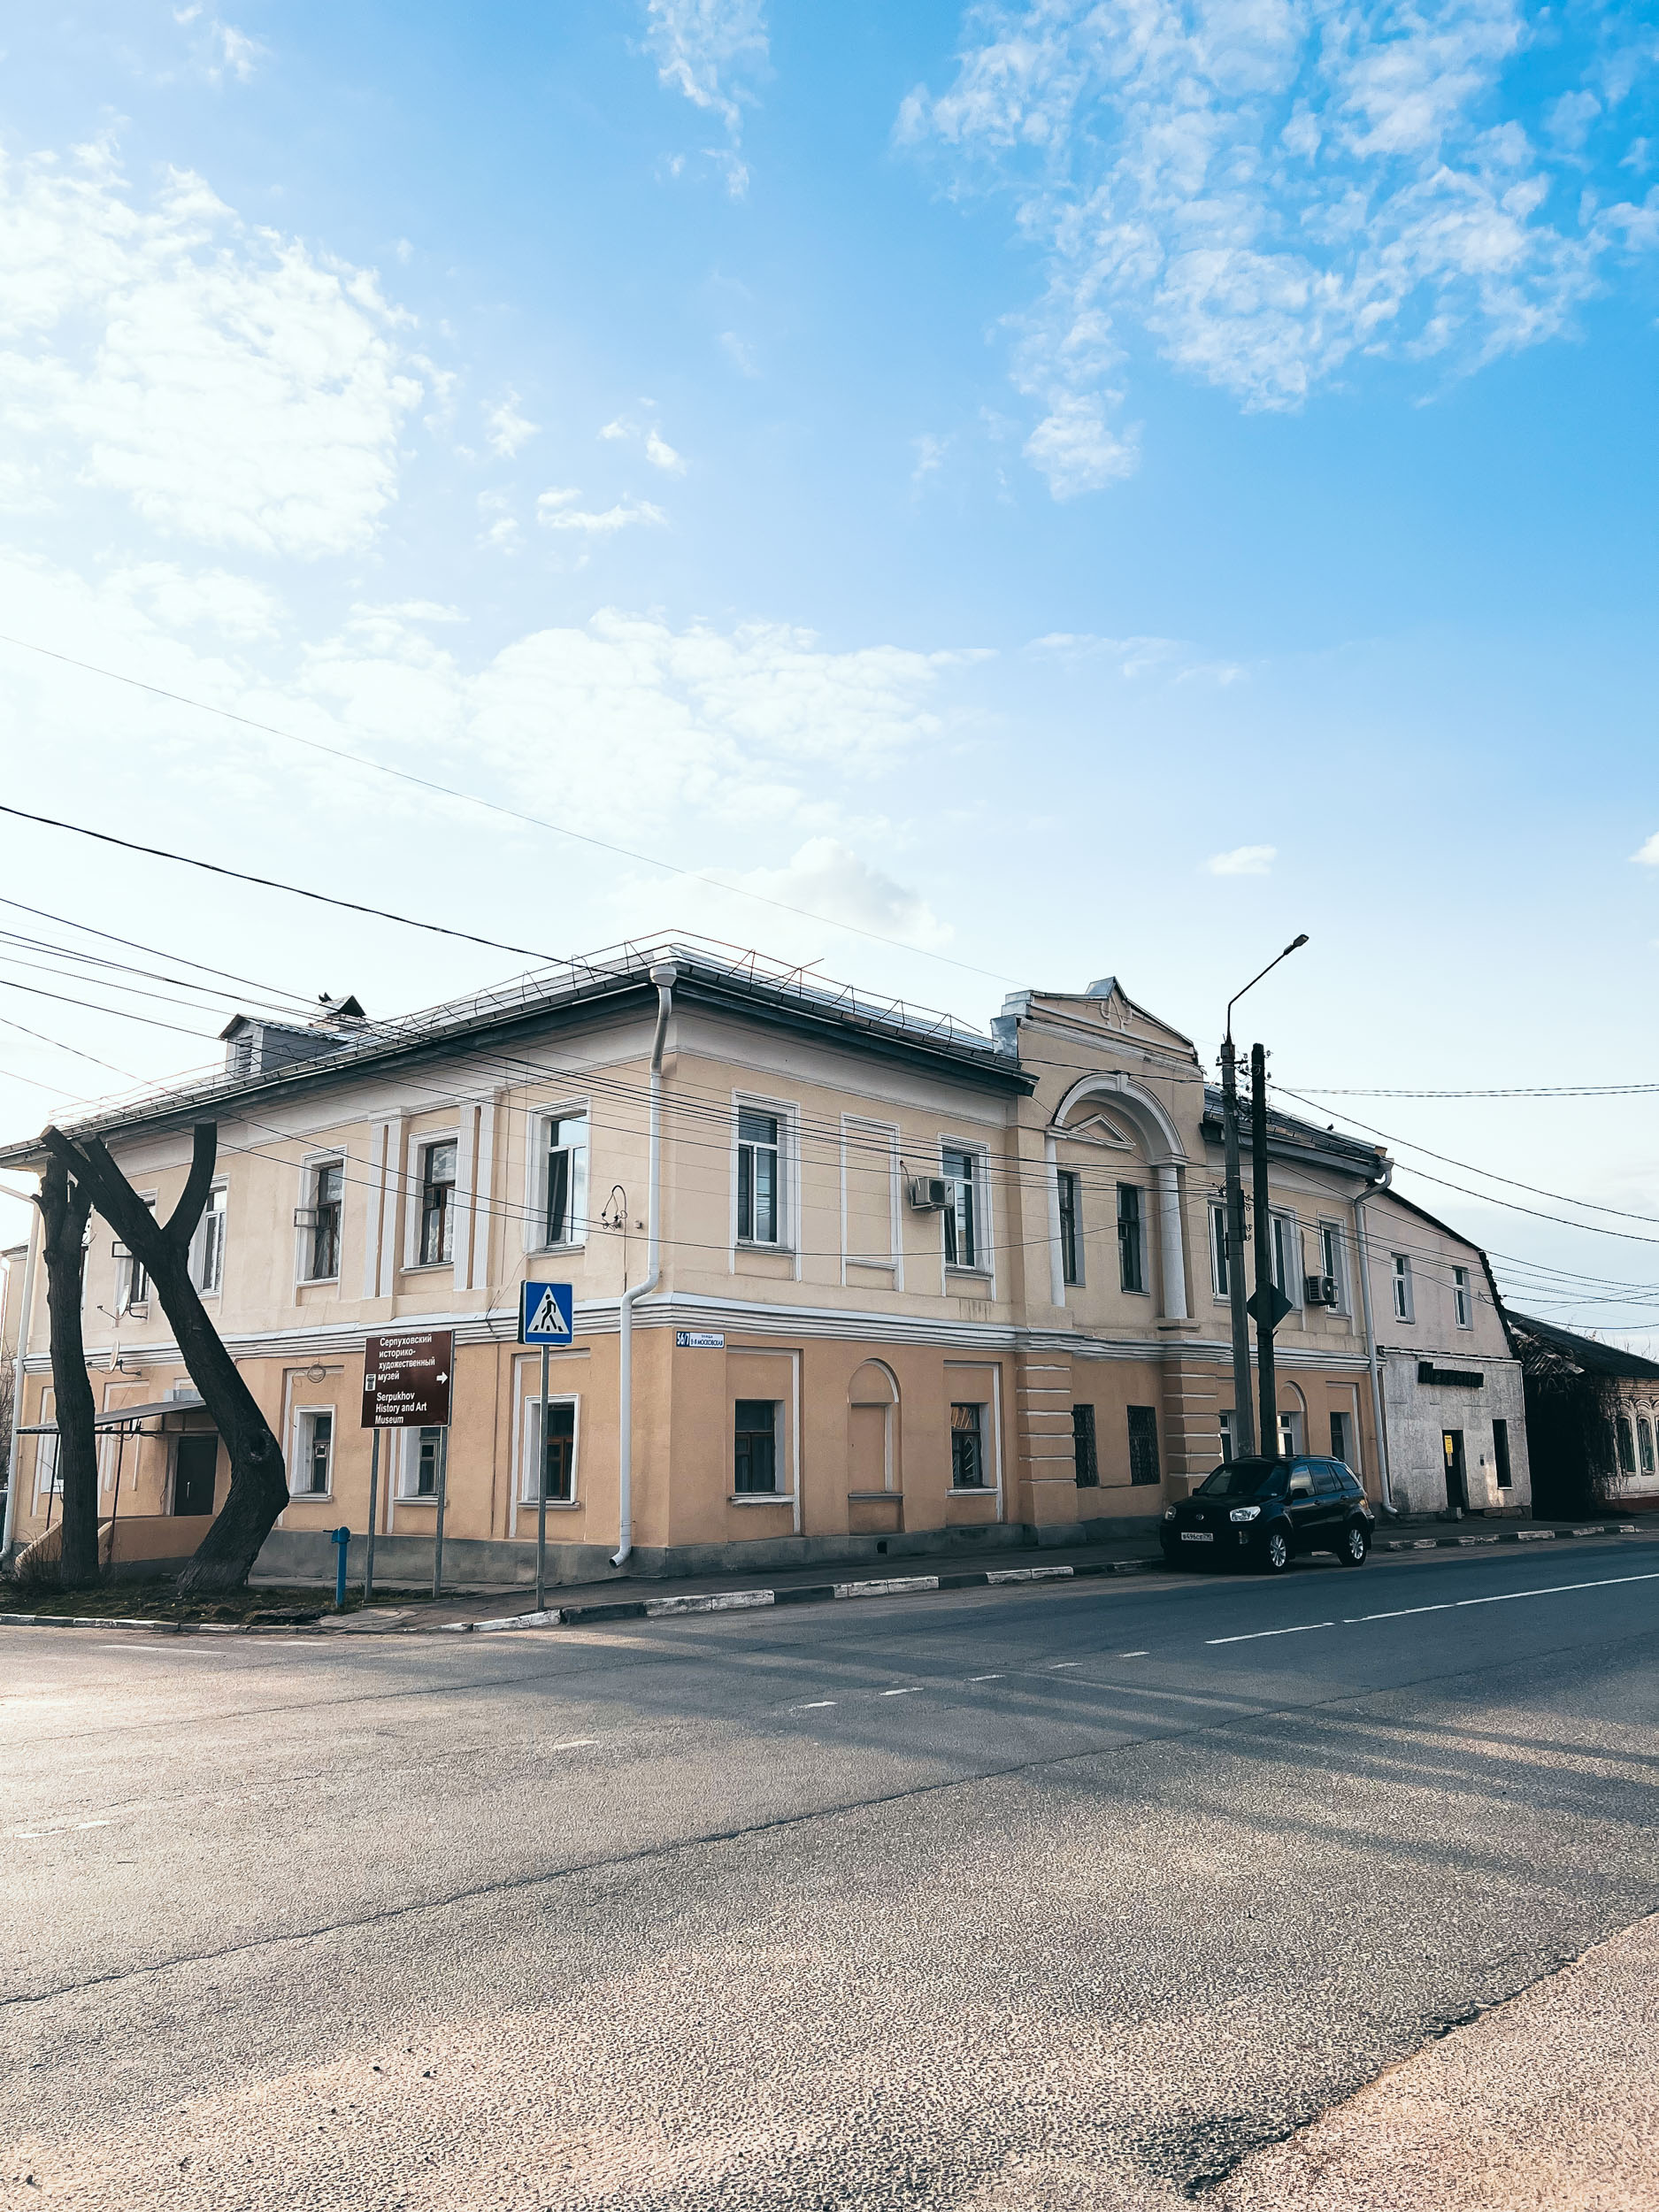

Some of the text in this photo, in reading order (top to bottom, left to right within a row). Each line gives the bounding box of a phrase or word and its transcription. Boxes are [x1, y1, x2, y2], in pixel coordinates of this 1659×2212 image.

[380, 1334, 432, 1347] Серпуховский
[677, 1333, 689, 1345] 56/7
[379, 1348, 416, 1359] историко-
[379, 1356, 435, 1371] художественный
[378, 1371, 399, 1383] музей
[376, 1391, 415, 1402] Serpukhov
[375, 1402, 427, 1414] History and Art
[375, 1415, 404, 1425] Museum
